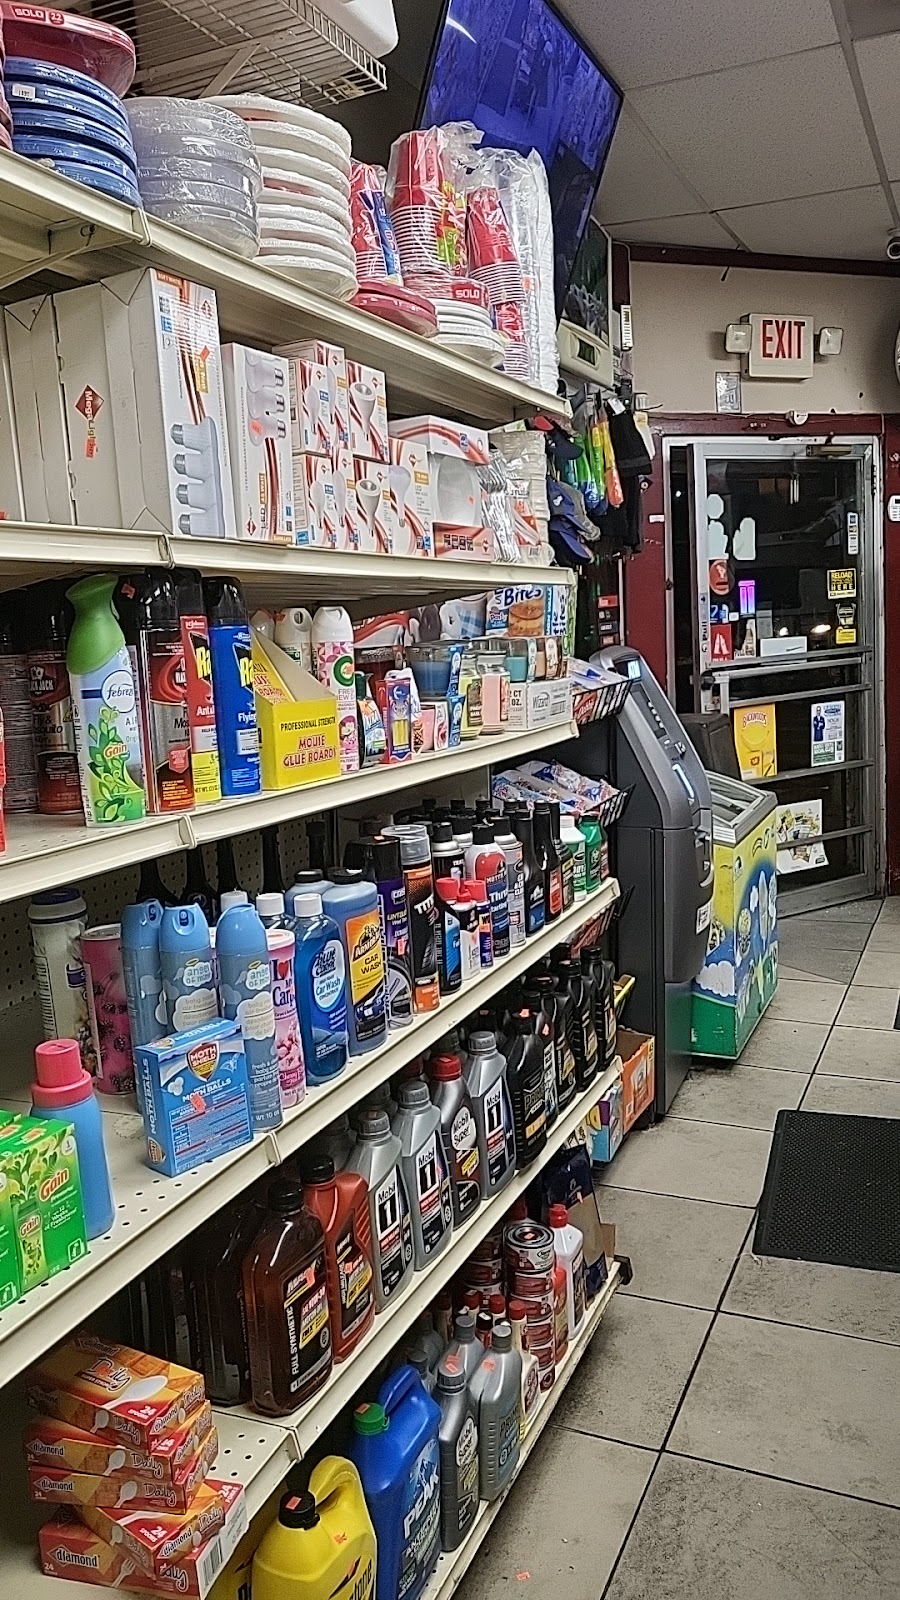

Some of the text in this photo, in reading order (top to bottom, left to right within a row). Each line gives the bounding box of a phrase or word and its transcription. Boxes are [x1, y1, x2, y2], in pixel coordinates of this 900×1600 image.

[15, 8, 44, 19] SOLO
[455, 289, 480, 299] SOLO
[761, 319, 806, 359] EXIT
[504, 584, 542, 607] Bites
[280, 720, 317, 732] PROFESSIONAL
[104, 743, 127, 758] Gain
[283, 753, 305, 767] GLUE
[364, 954, 378, 965] CAR
[361, 962, 381, 974] WASH
[315, 976, 341, 996] Car Wash
[189, 1045, 217, 1060] MOTH
[191, 1053, 217, 1067] SHIELD
[207, 1077, 232, 1093] BALLS
[40, 1168, 68, 1200] Gain
[20, 1215, 40, 1238] Gain
[286, 1305, 298, 1355] SYNTHETIC
[291, 1355, 299, 1376] FULL
[140, 1405, 158, 1416] 24
[33, 1442, 65, 1456] diamond
[131, 1452, 164, 1479] Daily
[41, 1476, 74, 1491] diamond
[143, 1482, 177, 1508] Daily
[150, 1526, 168, 1539] 24
[163, 1527, 193, 1556] diamond
[56, 1548, 98, 1568] diamond
